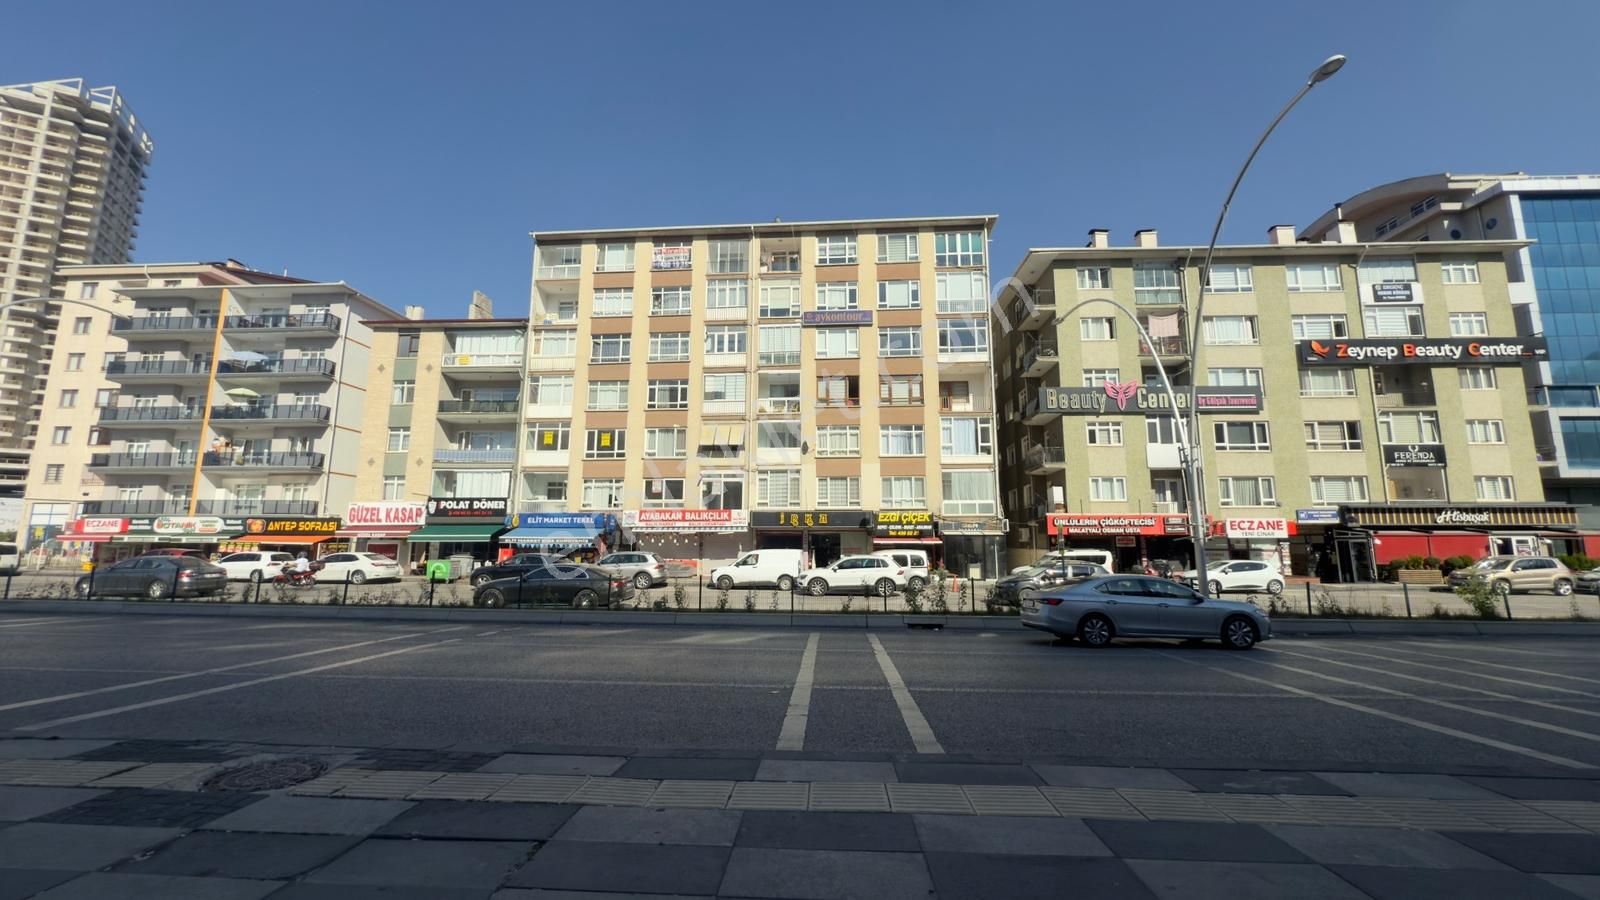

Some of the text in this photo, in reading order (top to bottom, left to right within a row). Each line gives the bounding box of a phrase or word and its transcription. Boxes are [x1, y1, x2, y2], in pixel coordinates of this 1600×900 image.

[1336, 343, 1398, 359] Zeynep
[1403, 343, 1463, 359] Beauty
[1046, 387, 1191, 413] Beauty Cene
[440, 498, 505, 509] POLAT DÖNER
[349, 505, 423, 523] GÜZEL KASAP
[640, 511, 682, 521] AYABAKAN
[684, 511, 729, 523] BALIKÇILIK
[878, 511, 930, 524] EZGİ ÇİÇEK
[86, 520, 119, 528] ECZANE
[527, 516, 542, 524] ELİT
[1229, 520, 1284, 531] ECZANE
[267, 521, 338, 531] ANTEP SOFRASI
